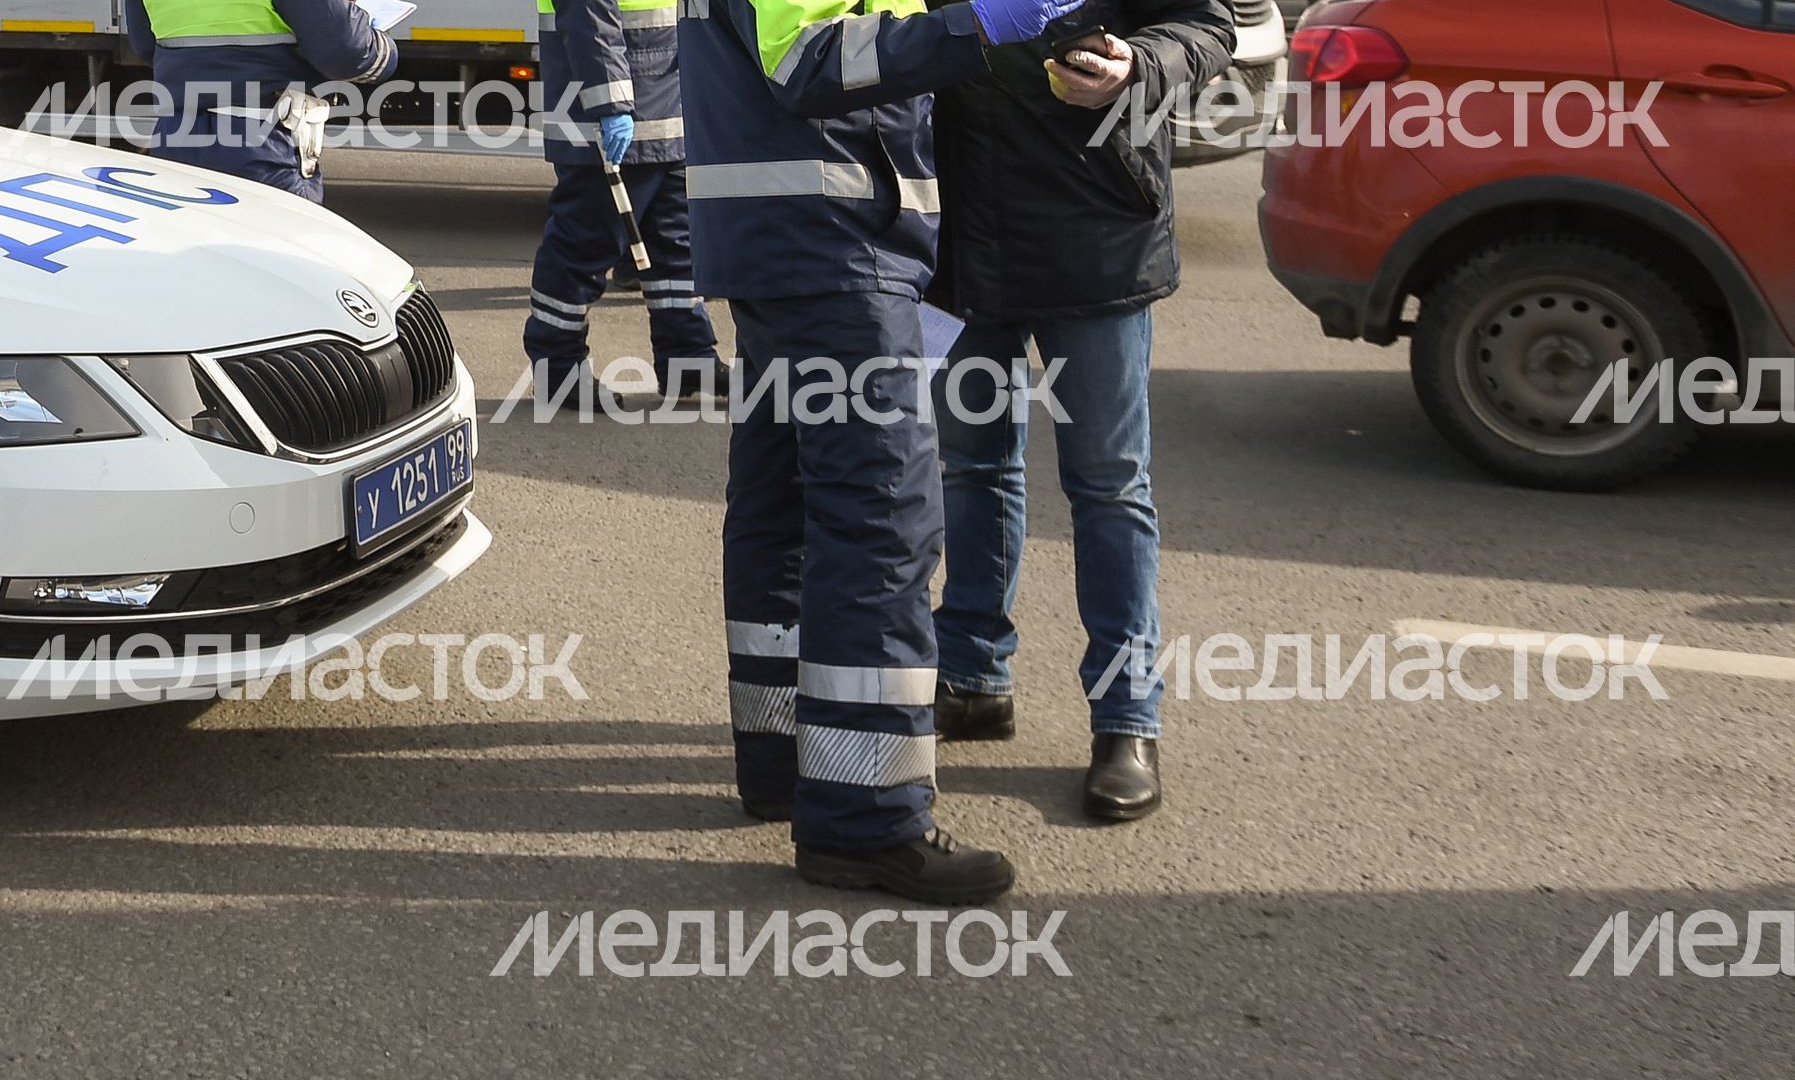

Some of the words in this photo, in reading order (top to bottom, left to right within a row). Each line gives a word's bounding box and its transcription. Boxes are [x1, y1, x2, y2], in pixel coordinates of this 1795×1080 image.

[391, 447, 439, 515] 1251
[447, 429, 465, 469] 99
[451, 466, 465, 483] RUS
